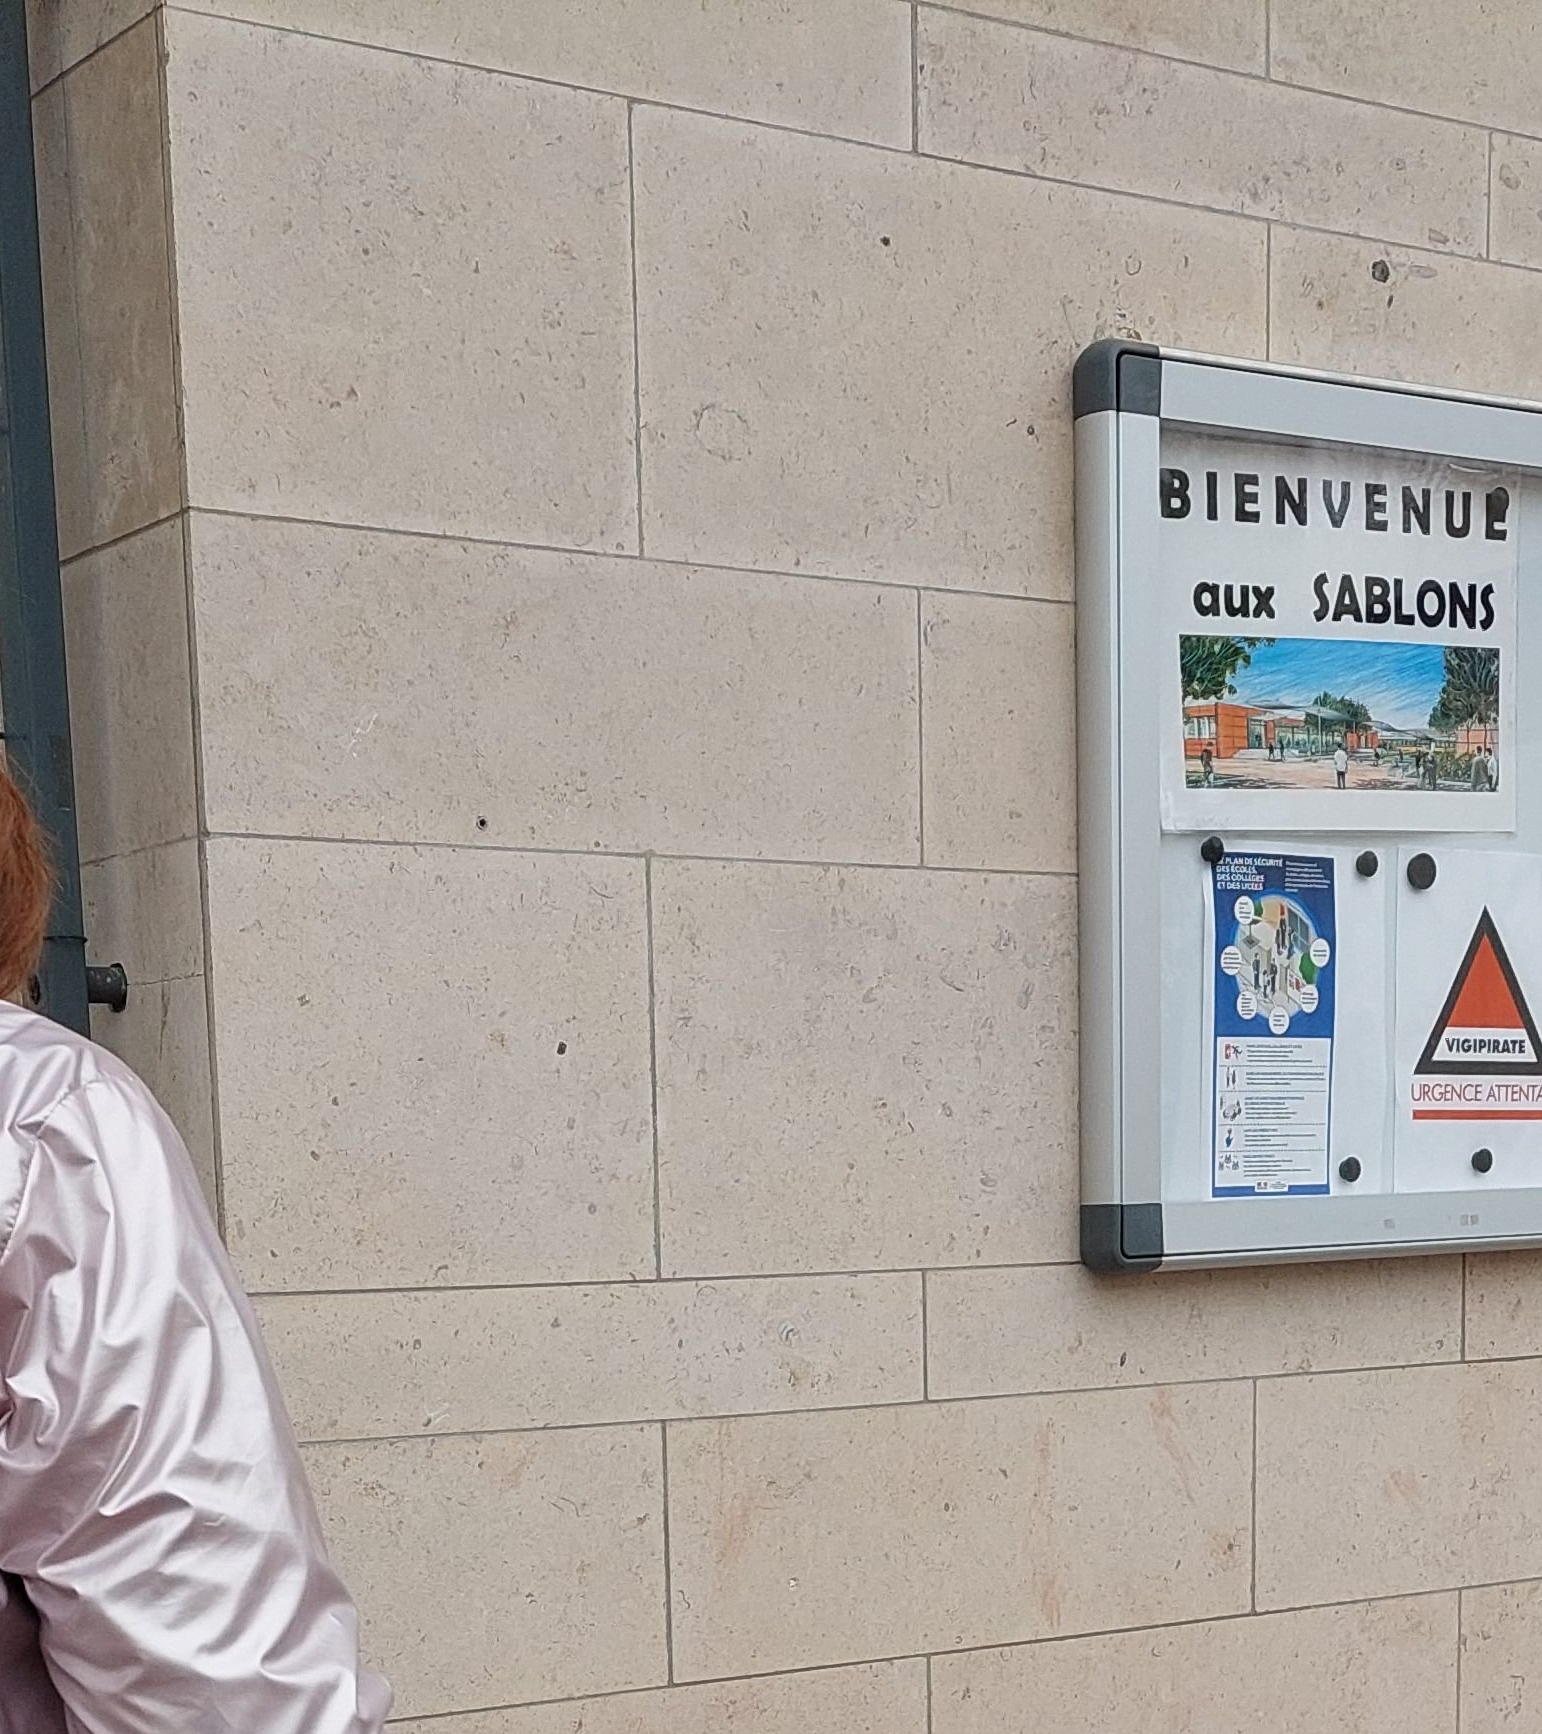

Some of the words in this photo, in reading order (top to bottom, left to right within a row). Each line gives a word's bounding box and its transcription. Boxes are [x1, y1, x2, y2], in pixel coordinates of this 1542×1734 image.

[1193, 581, 1275, 619] aux
[1313, 572, 1495, 632] SABLONS
[1445, 1038, 1526, 1054] VIGIPIRATE
[1411, 1083, 1483, 1102] URGENCE
